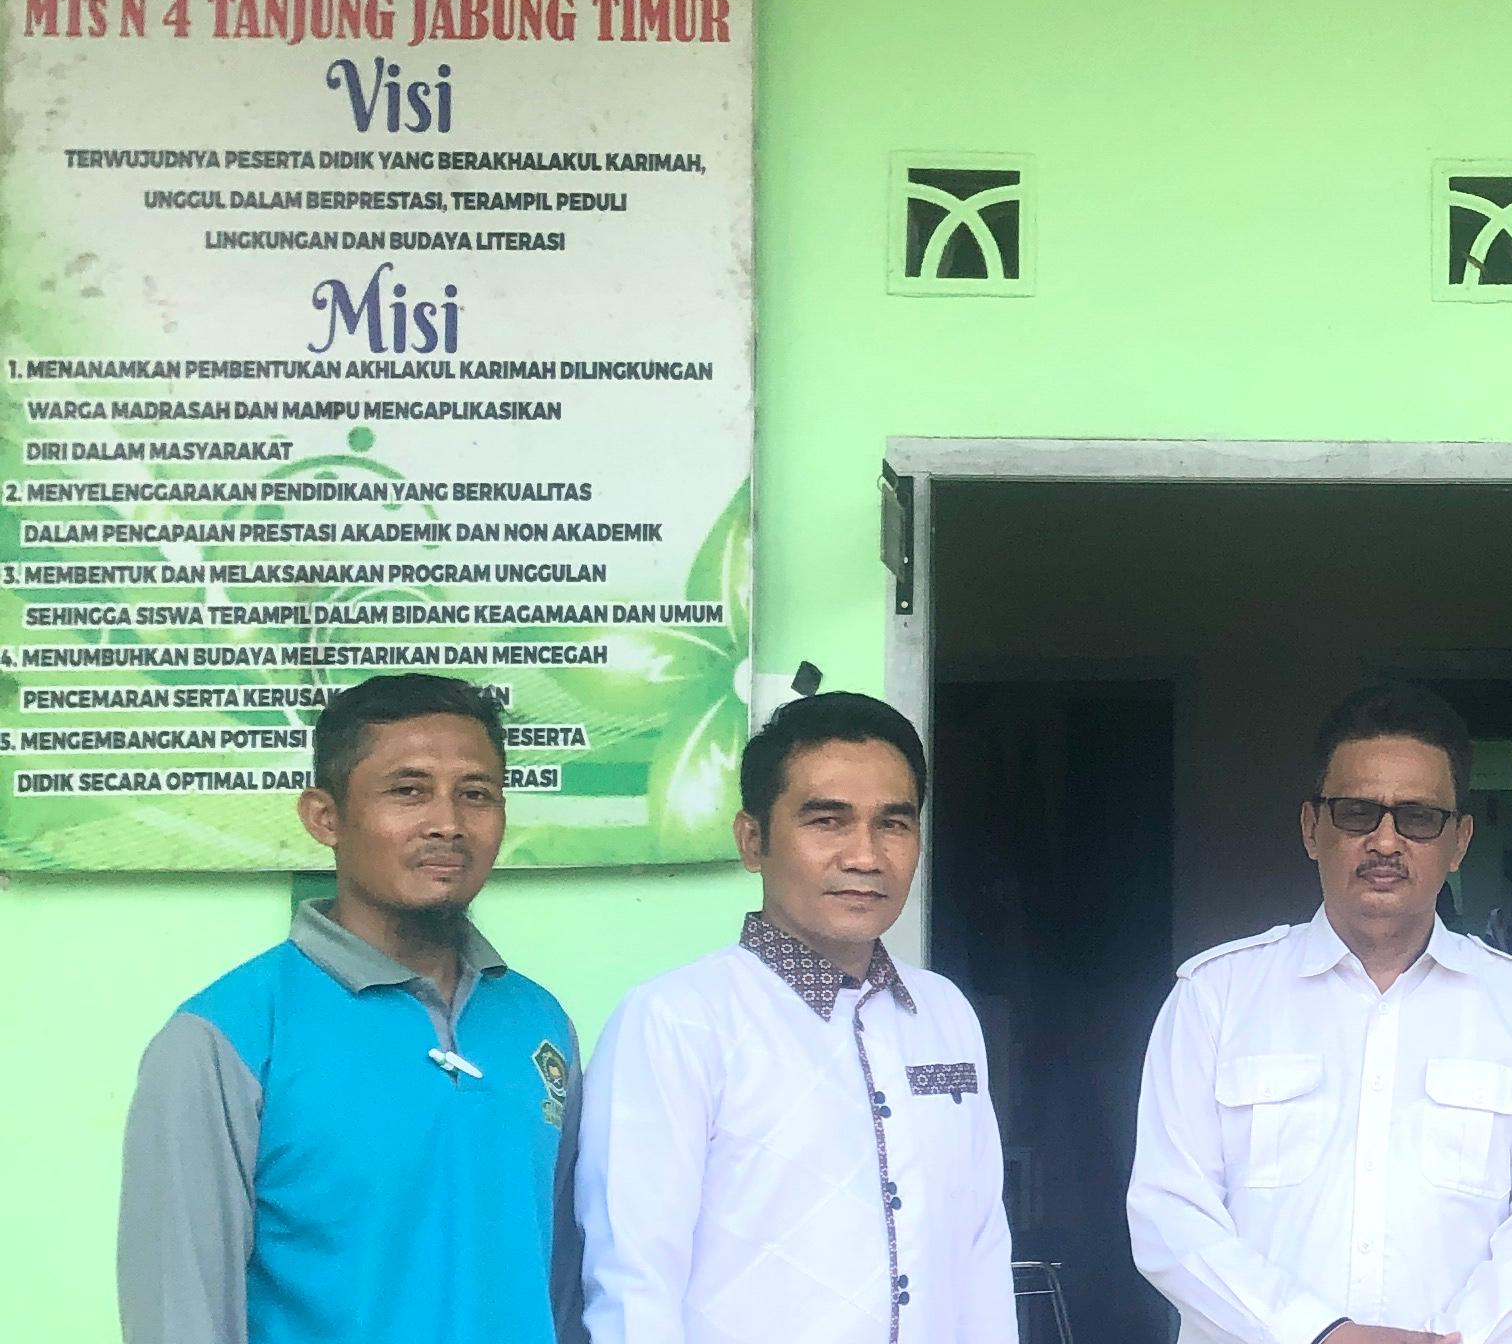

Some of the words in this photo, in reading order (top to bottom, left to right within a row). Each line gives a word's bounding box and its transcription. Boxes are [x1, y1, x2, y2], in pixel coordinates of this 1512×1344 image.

[326, 56, 452, 133] Visi
[65, 149, 220, 169] TERWUJUDNYA
[225, 150, 315, 170] PESERTA
[320, 150, 374, 170] DIDIK
[380, 151, 433, 170] YANG
[438, 151, 602, 171] BERAKHALAKUL
[606, 152, 706, 175] KARIMAH,
[144, 190, 225, 210] UNGGUL
[231, 190, 300, 210] DALAM
[306, 190, 447, 214] BERPRESTASI,
[451, 191, 553, 211] TERAMPIL
[557, 192, 628, 212] PEDULI
[205, 230, 338, 250] LINGKUNGAN
[343, 231, 385, 250] DAN
[390, 231, 472, 251] BUDAYA
[476, 231, 565, 251] LITERASI
[307, 262, 458, 354] Misi
[8, 359, 23, 379] 1.
[26, 360, 180, 379] MENANAMKAN
[186, 360, 341, 379] PEMBENTUKAN
[345, 360, 455, 380] AKHLAKUL
[460, 360, 556, 380] KARIMAH
[560, 361, 713, 381] DILINGKUNGAN
[27, 400, 107, 420] WARGA
[111, 401, 231, 420] MADRASAH
[234, 400, 278, 420] DAN
[282, 400, 360, 420] MAMPU
[364, 401, 562, 421] MENGAPLIKASIKAN
[26, 442, 68, 461] DIRI
[72, 442, 145, 461] DALAM
[149, 441, 293, 461] MASYARAKAT
[6, 483, 22, 503] 2.
[26, 482, 257, 502] MENYELENGGARAKAN
[261, 482, 388, 502] PENDIDIKAN
[392, 482, 448, 502] YANG
[453, 482, 592, 502] BERKUALITAS
[24, 524, 98, 543] DALAM
[102, 523, 236, 543] PENCAPAIAN
[239, 523, 337, 543] PRESTASI
[341, 523, 451, 542] AKADEMIK
[456, 523, 499, 542] DAN
[504, 523, 548, 542] NON
[552, 523, 663, 542] AKADEMIK
[3, 565, 20, 585] 3.
[24, 565, 157, 585] MEMBENTUK
[161, 564, 205, 584] DAN
[209, 564, 384, 584] MELAKSANAKAN
[388, 564, 491, 583] PROGRAM
[495, 563, 607, 583] UNGGULAN
[26, 606, 131, 626] SEHINGGA
[136, 606, 203, 626] SISWA
[208, 605, 311, 625] TERAMPIL
[314, 605, 388, 625] DALAM
[392, 605, 470, 624] BIDANG
[474, 604, 608, 624] KEAGAMAAN
[612, 604, 655, 624] DAN
[660, 604, 723, 624] UMUM
[22, 647, 189, 667] MENUMBUHKAN
[193, 646, 276, 666] BUDAYA
[281, 646, 440, 666] MELESTARIKAN
[445, 646, 488, 665] DAN
[492, 645, 607, 665] MENCEGAH
[23, 689, 169, 709] PENCEMARAN
[173, 688, 239, 708] SERTA
[0, 732, 16, 751] 5.
[20, 730, 216, 751] MENGEMBANGKAN
[220, 729, 307, 749] POTENSI
[17, 773, 73, 793] DIDIK
[78, 772, 162, 792] SECARA
[166, 771, 258, 791] OPTIMAL
[262, 770, 312, 790] DARI
